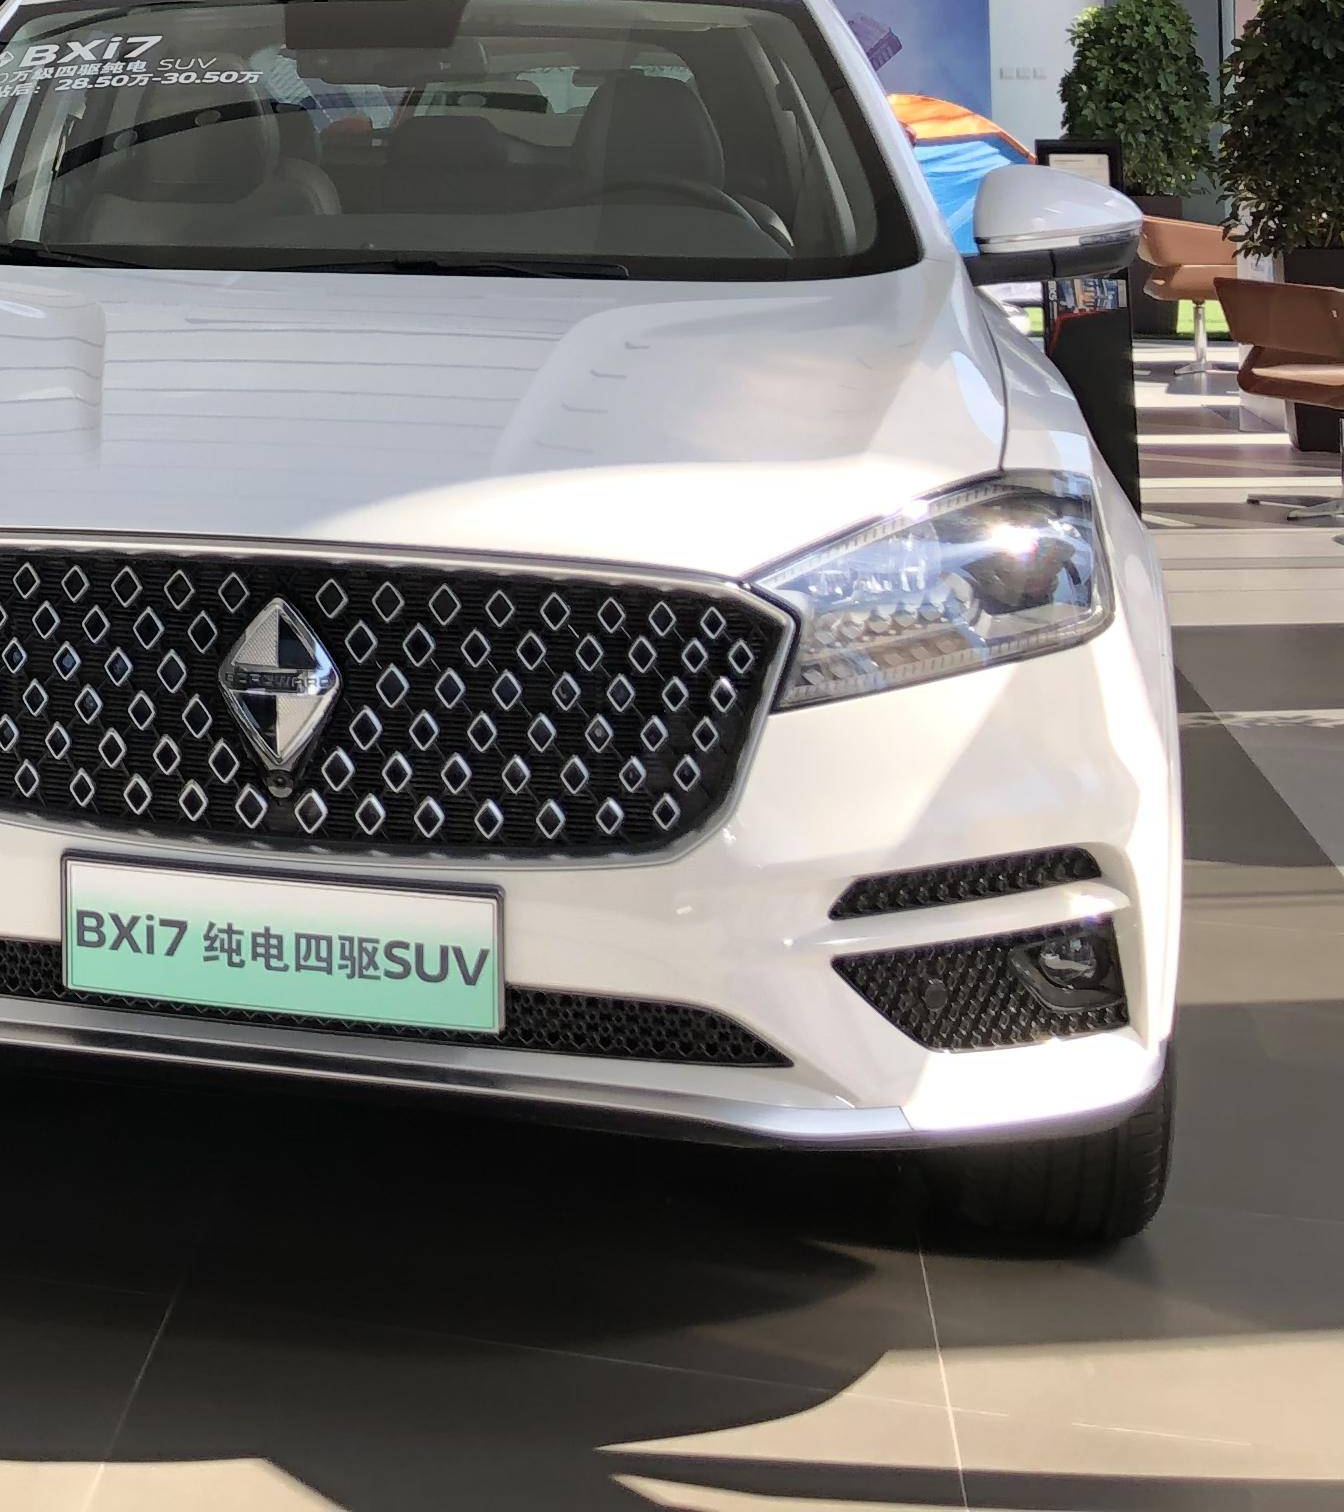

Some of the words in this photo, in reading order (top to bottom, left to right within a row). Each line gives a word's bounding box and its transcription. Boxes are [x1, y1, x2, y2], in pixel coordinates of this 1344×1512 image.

[19, 35, 163, 68] BXi7
[157, 56, 218, 72] SUV
[54, 70, 265, 92] 28.50万-30.50万
[75, 908, 189, 958] BXi7
[200, 920, 491, 987] 纯电四驱SUV
